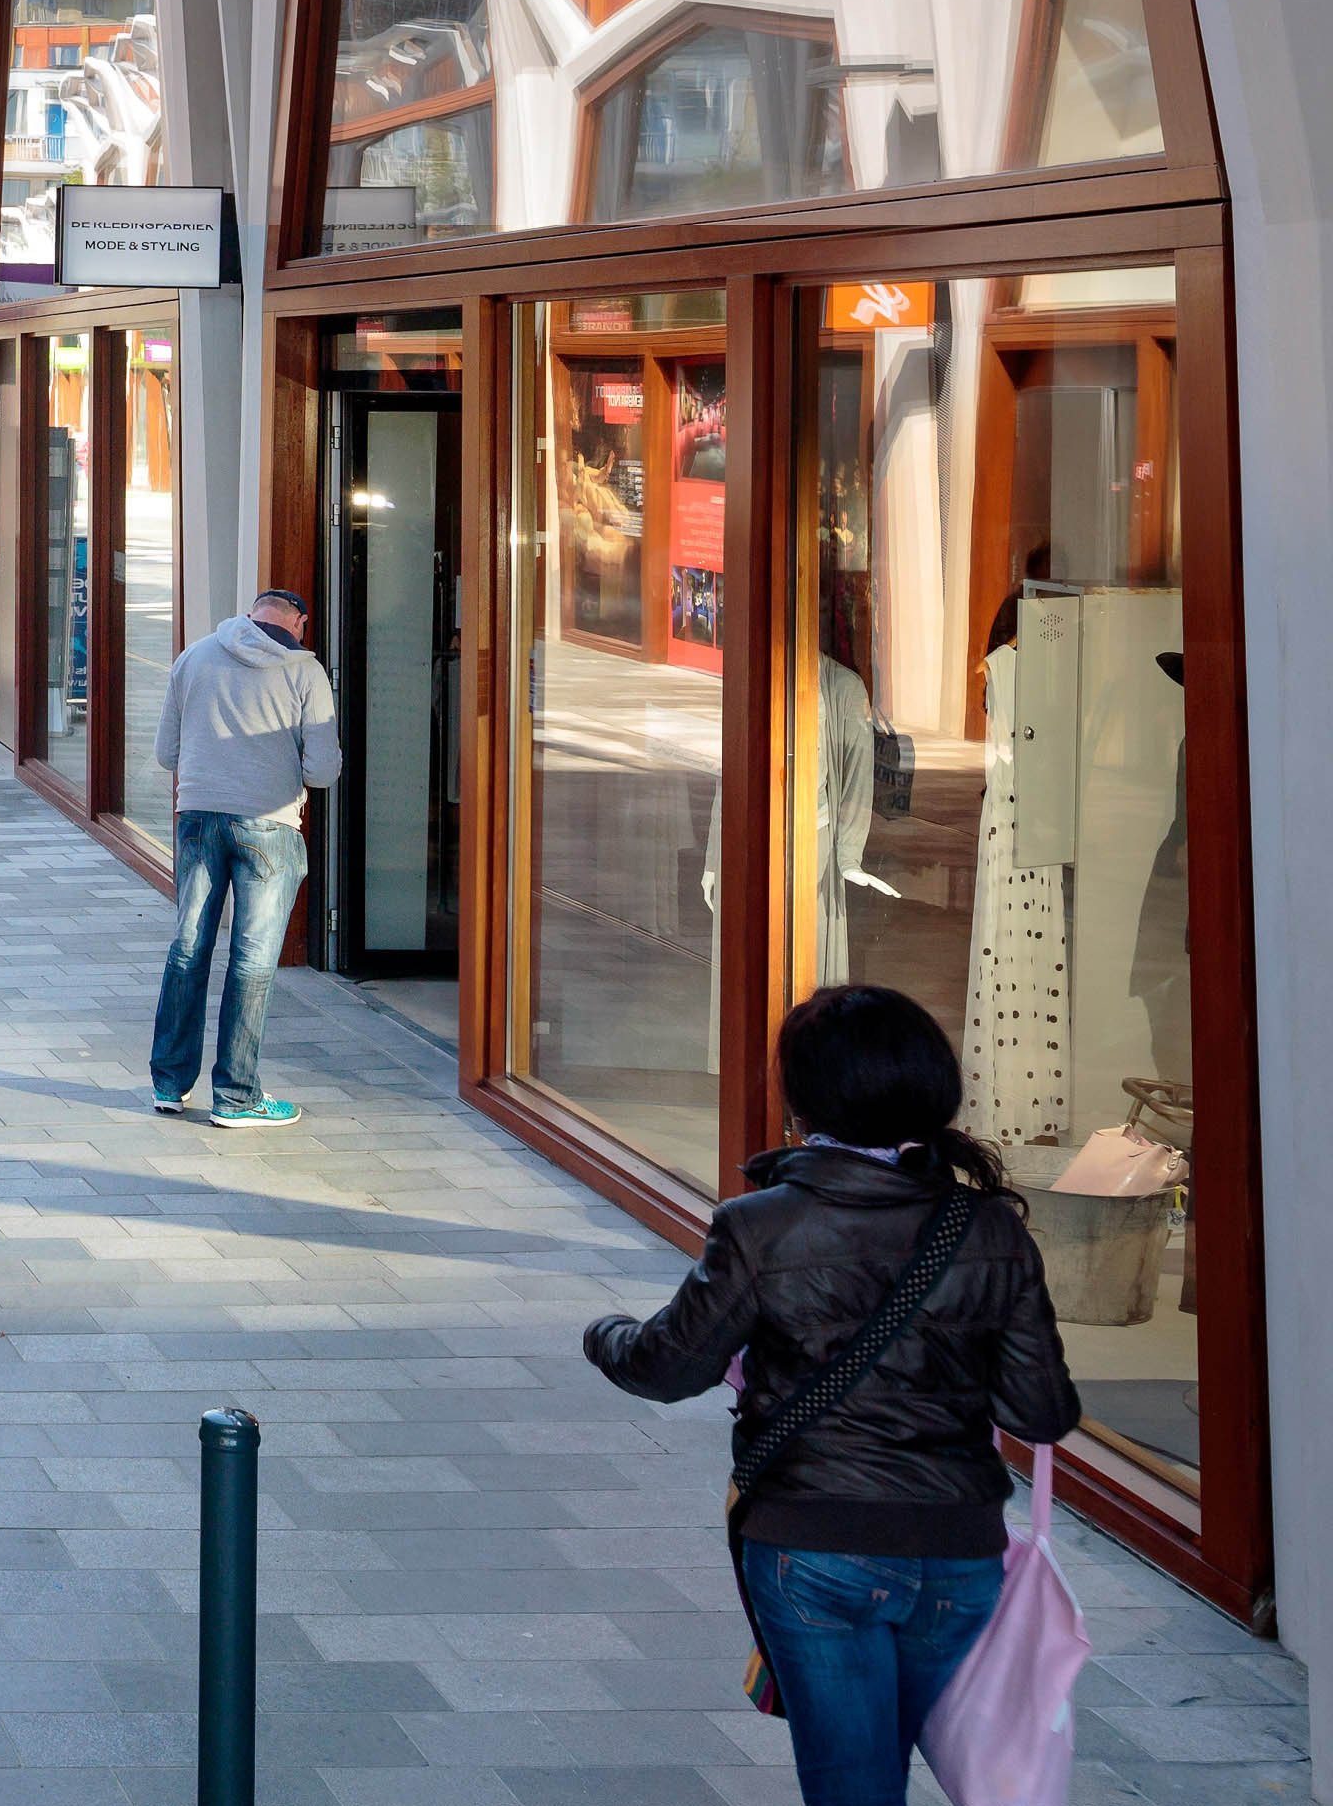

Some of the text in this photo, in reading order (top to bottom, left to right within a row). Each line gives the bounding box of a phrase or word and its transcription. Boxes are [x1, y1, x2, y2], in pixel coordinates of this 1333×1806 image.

[85, 240, 200, 252] MODE & STYLING
